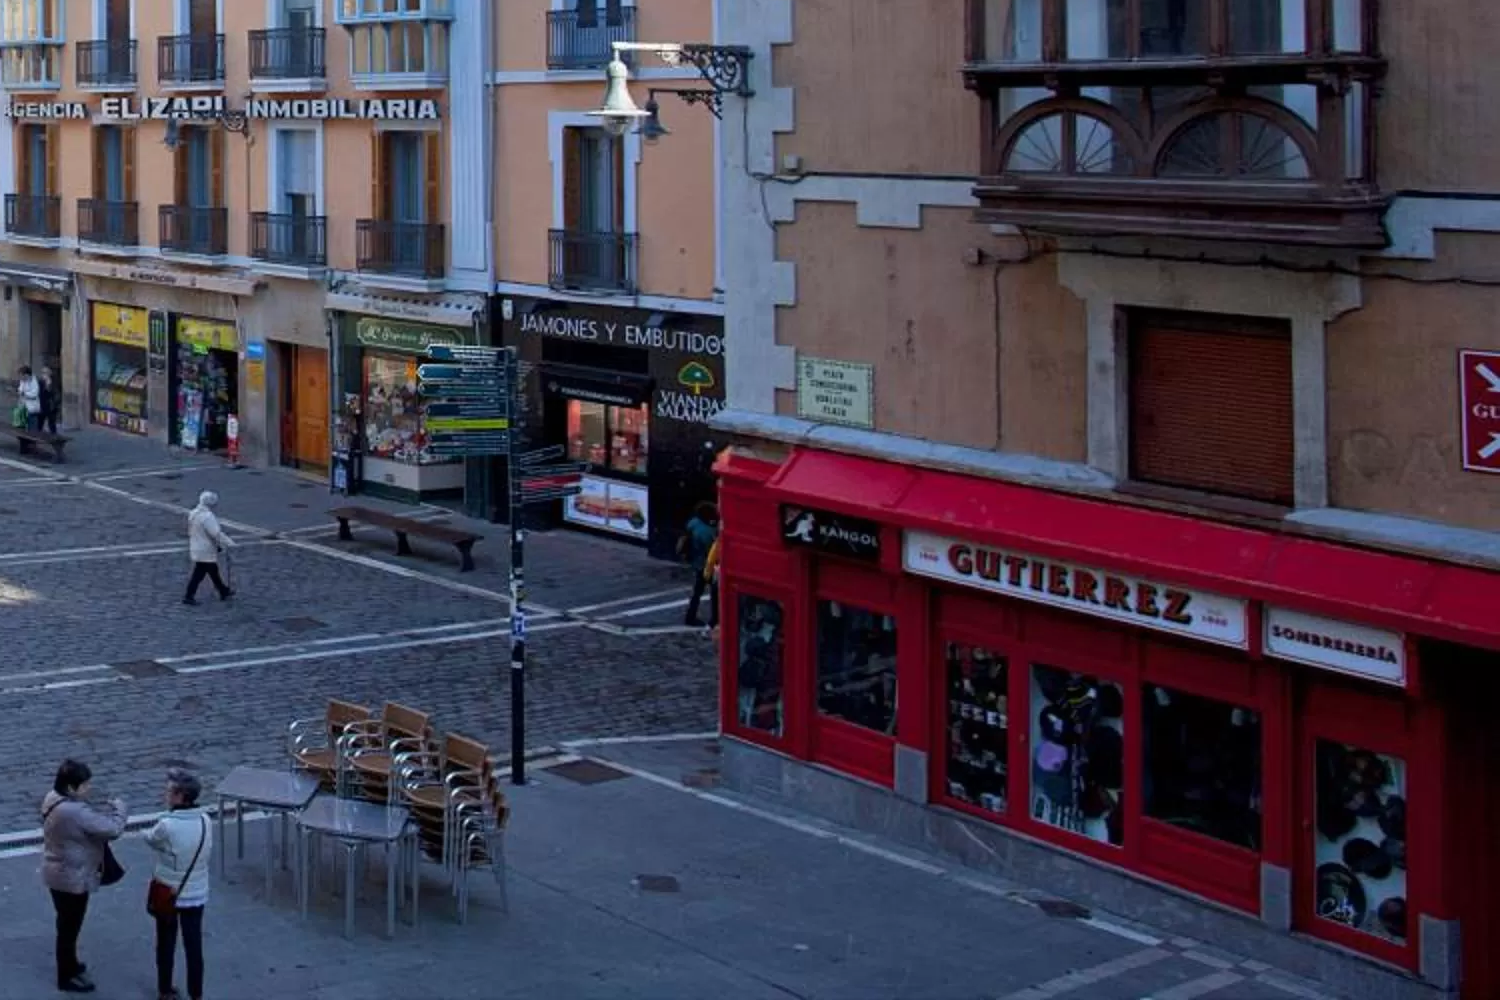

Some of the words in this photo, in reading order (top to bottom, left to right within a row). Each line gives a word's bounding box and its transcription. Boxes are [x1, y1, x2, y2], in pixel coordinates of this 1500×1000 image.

[245, 97, 438, 121] INMOBILIARIA
[520, 313, 598, 340] JAMONES
[604, 322, 617, 342] Y
[819, 524, 879, 548] KANGOL
[947, 543, 1193, 625] GUTIERREZ
[1271, 624, 1398, 665] SOMBRERERÍA
